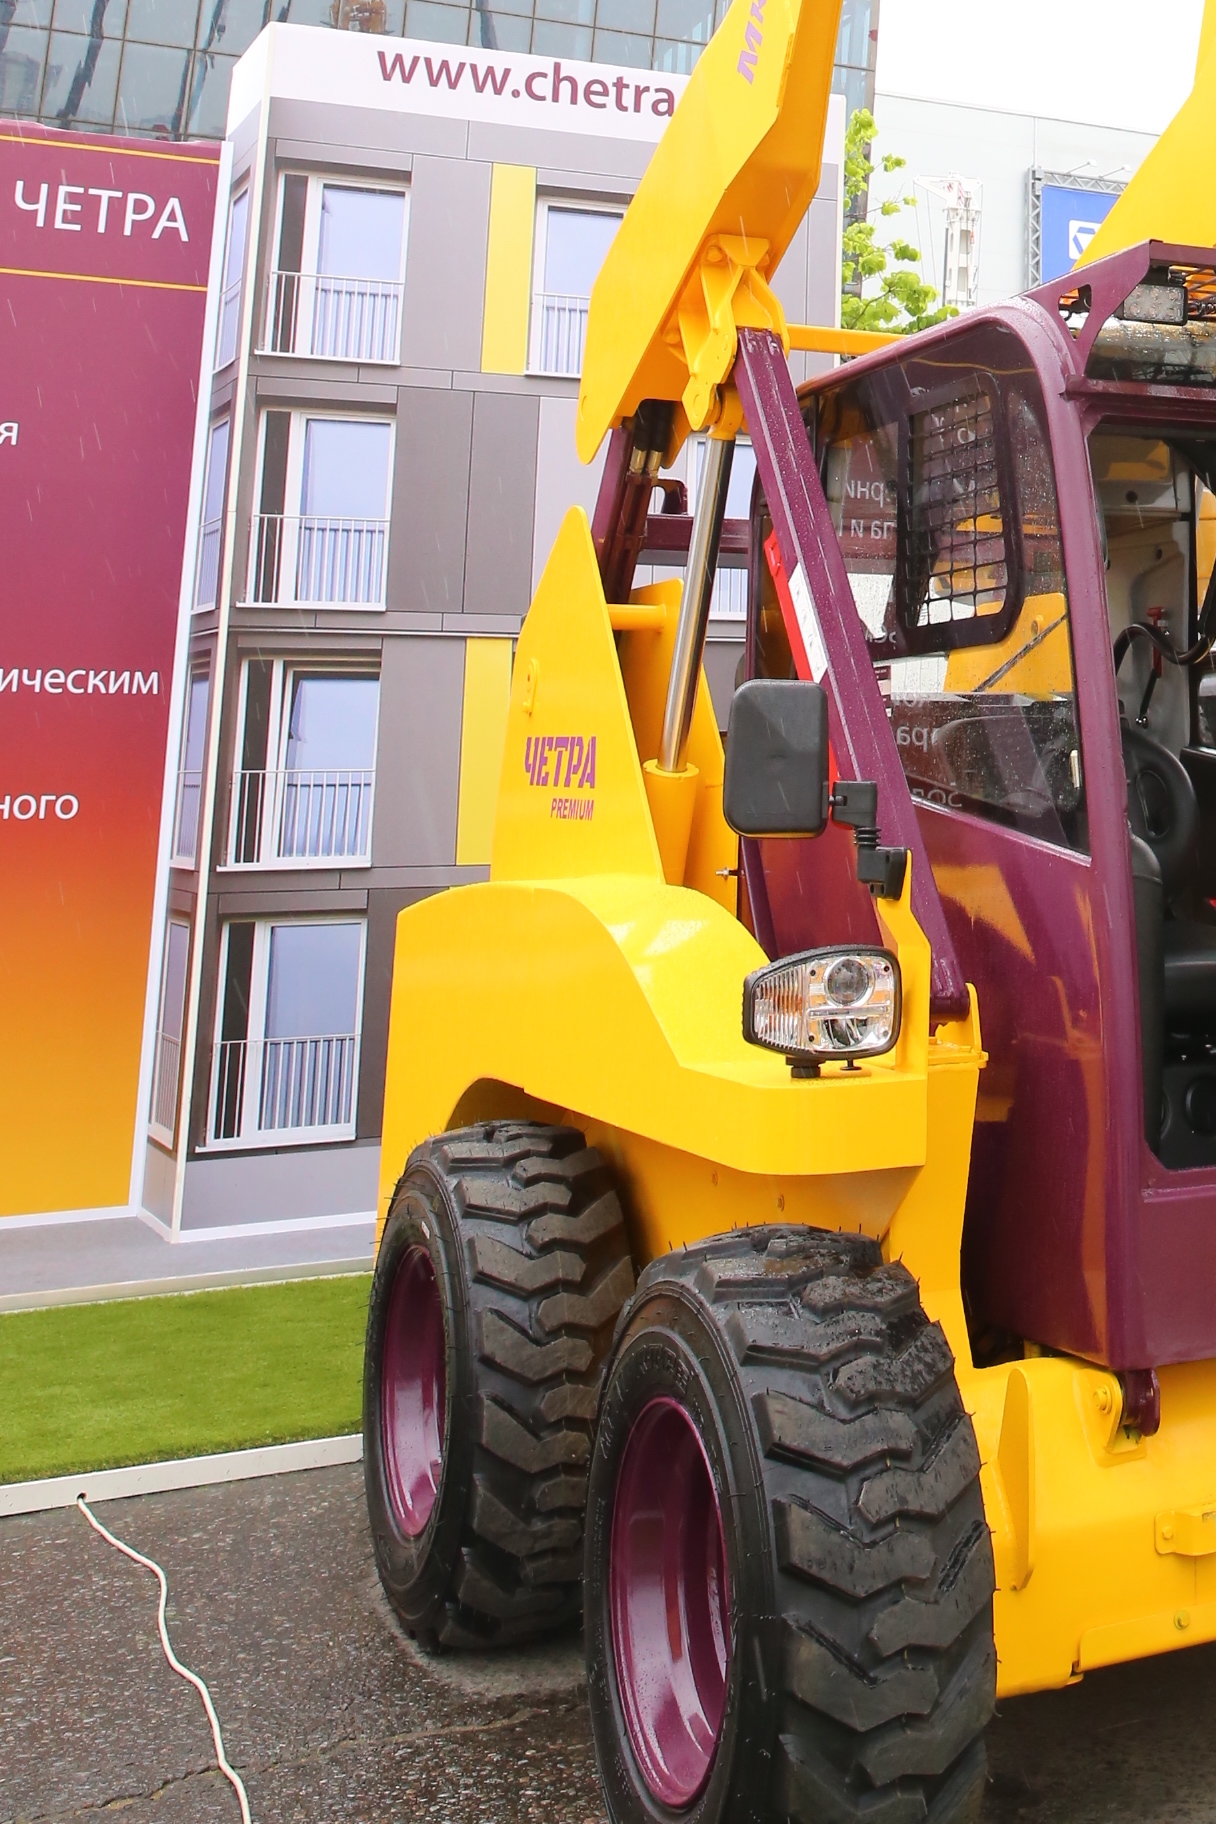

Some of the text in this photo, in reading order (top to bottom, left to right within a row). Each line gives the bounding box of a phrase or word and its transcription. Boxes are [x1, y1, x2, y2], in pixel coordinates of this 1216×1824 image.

[377, 50, 675, 117] www.chetra
[14, 180, 189, 242] ЧЕТРА
[524, 736, 596, 789] ЧЕТРА
[550, 797, 594, 821] PREMIUM
